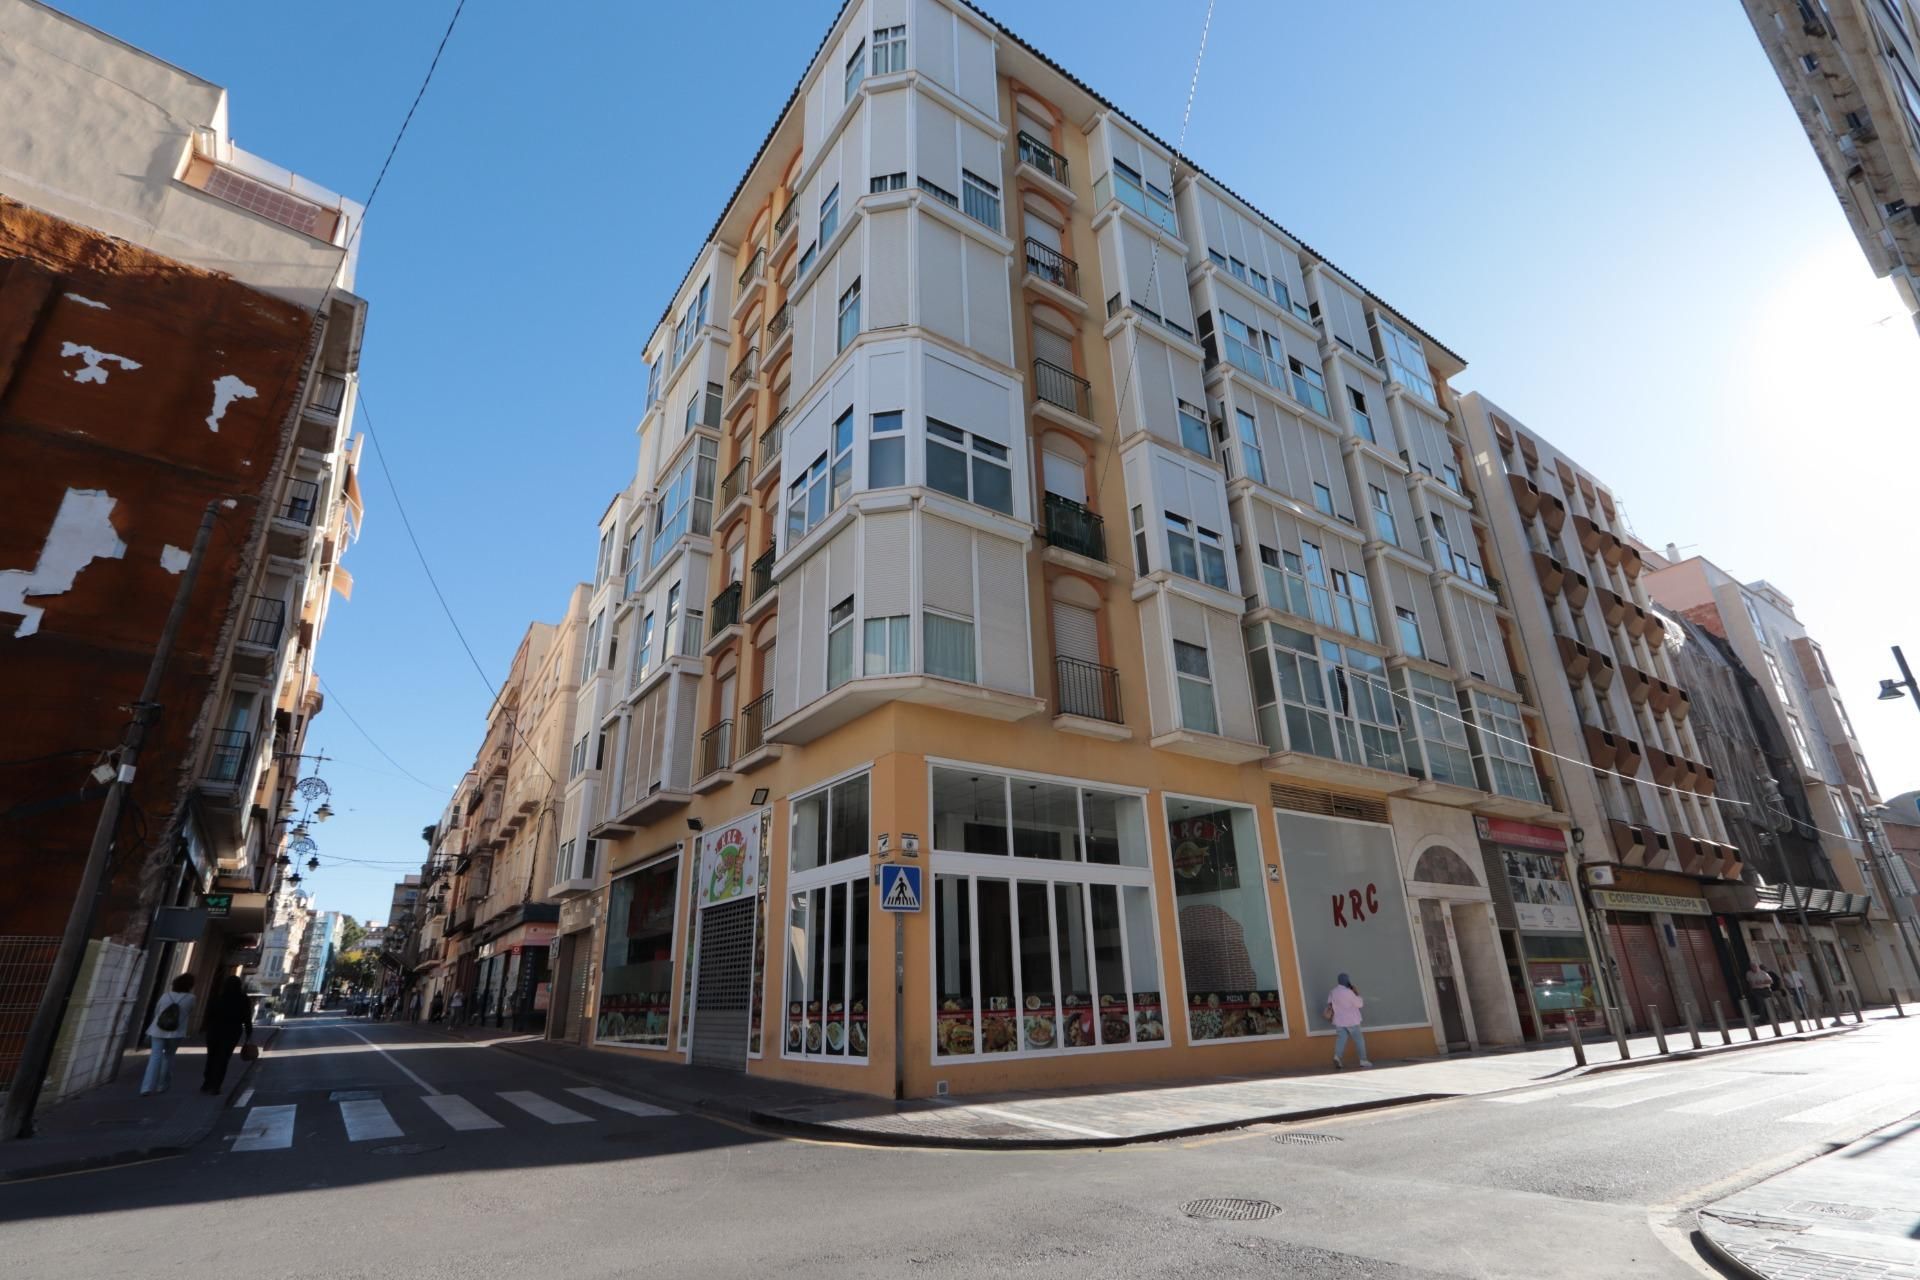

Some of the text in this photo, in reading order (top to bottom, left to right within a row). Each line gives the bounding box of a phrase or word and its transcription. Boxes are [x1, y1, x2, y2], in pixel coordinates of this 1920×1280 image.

[1332, 883, 1378, 928] KRC
[1608, 893, 1664, 906] COMERCIAL
[1664, 898, 1698, 909] EUROPA
